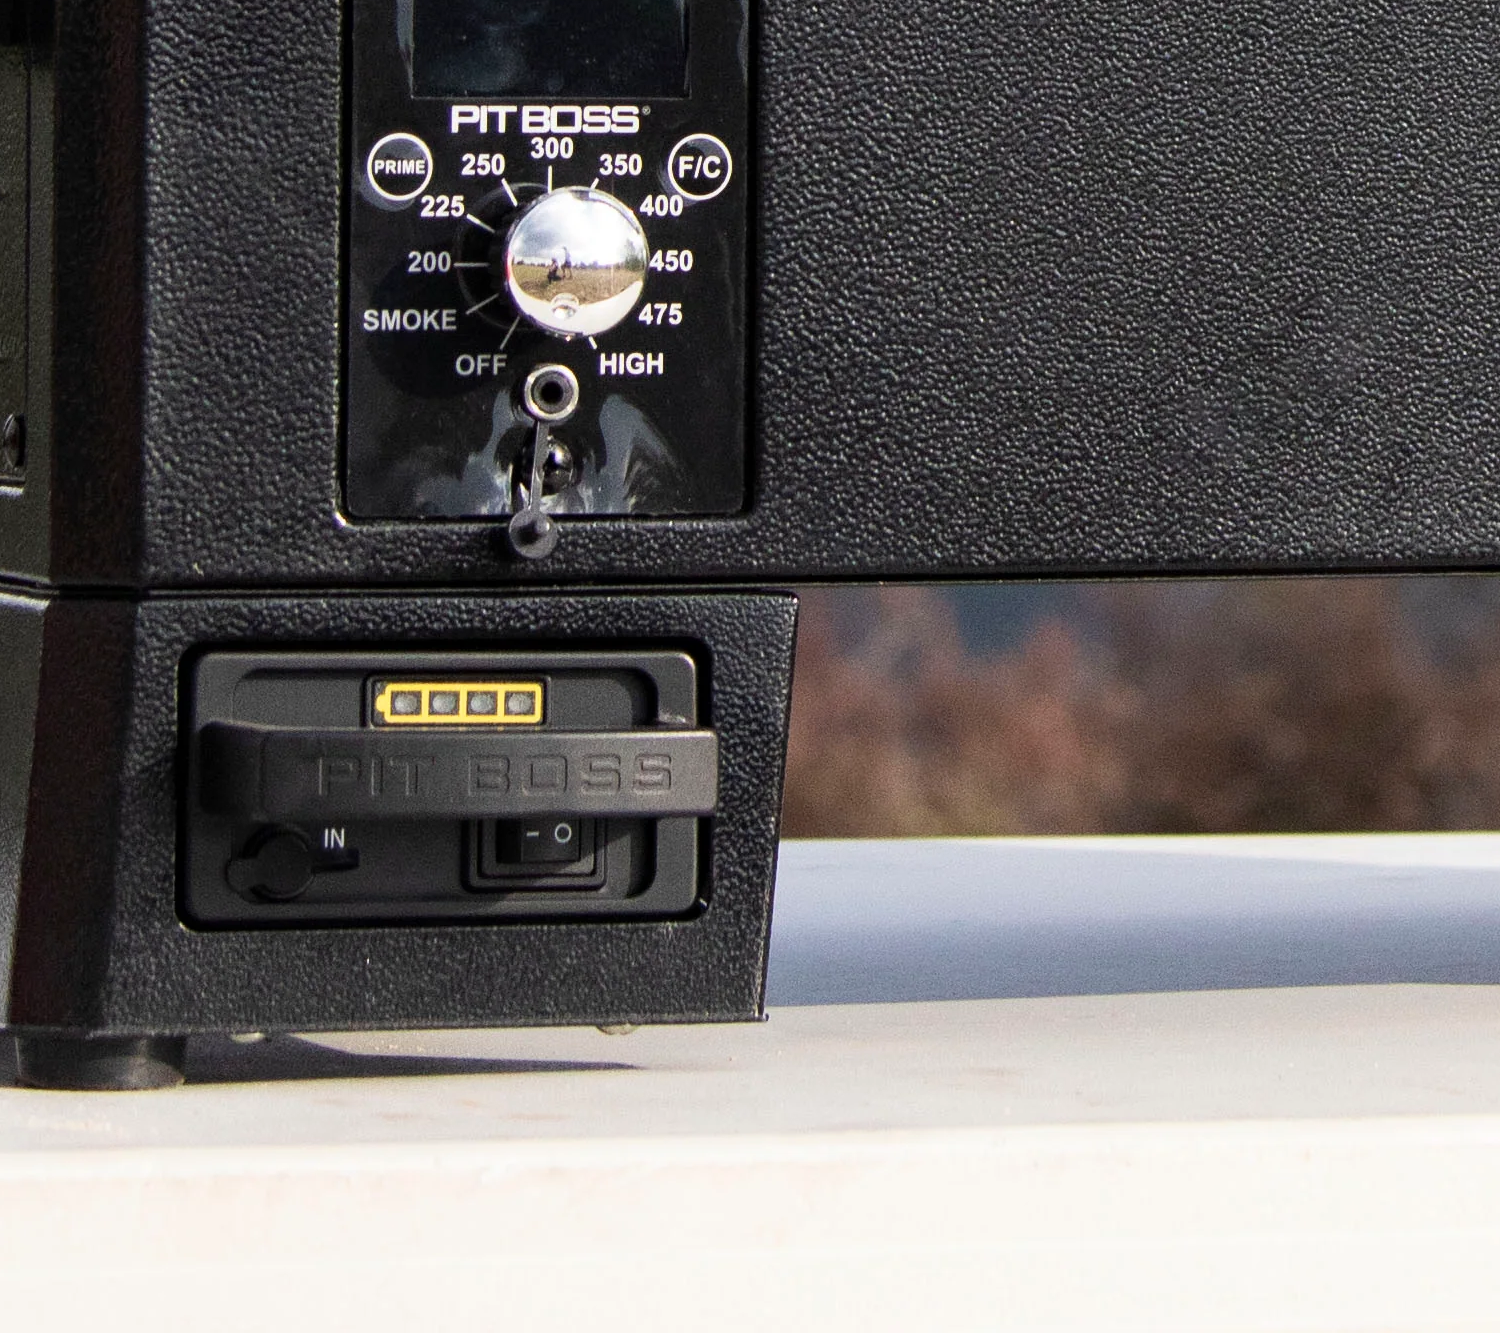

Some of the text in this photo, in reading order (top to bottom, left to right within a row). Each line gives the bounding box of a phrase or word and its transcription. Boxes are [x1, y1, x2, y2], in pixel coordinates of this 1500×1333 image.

[451, 105, 517, 132] PIT
[531, 137, 573, 159] 300
[374, 159, 425, 174] PRIME
[461, 154, 504, 176] 250
[599, 154, 642, 176] 350
[678, 156, 721, 179] F/C
[420, 195, 464, 217] 225
[640, 195, 682, 216] 400
[407, 251, 451, 272] 200
[649, 250, 693, 272] 450
[363, 309, 456, 331] SMOKE
[639, 303, 682, 325] 475
[455, 354, 507, 376] OFF
[599, 353, 663, 375] HIGH
[316, 753, 672, 796] PIT BOSS
[324, 829, 345, 847] IN
